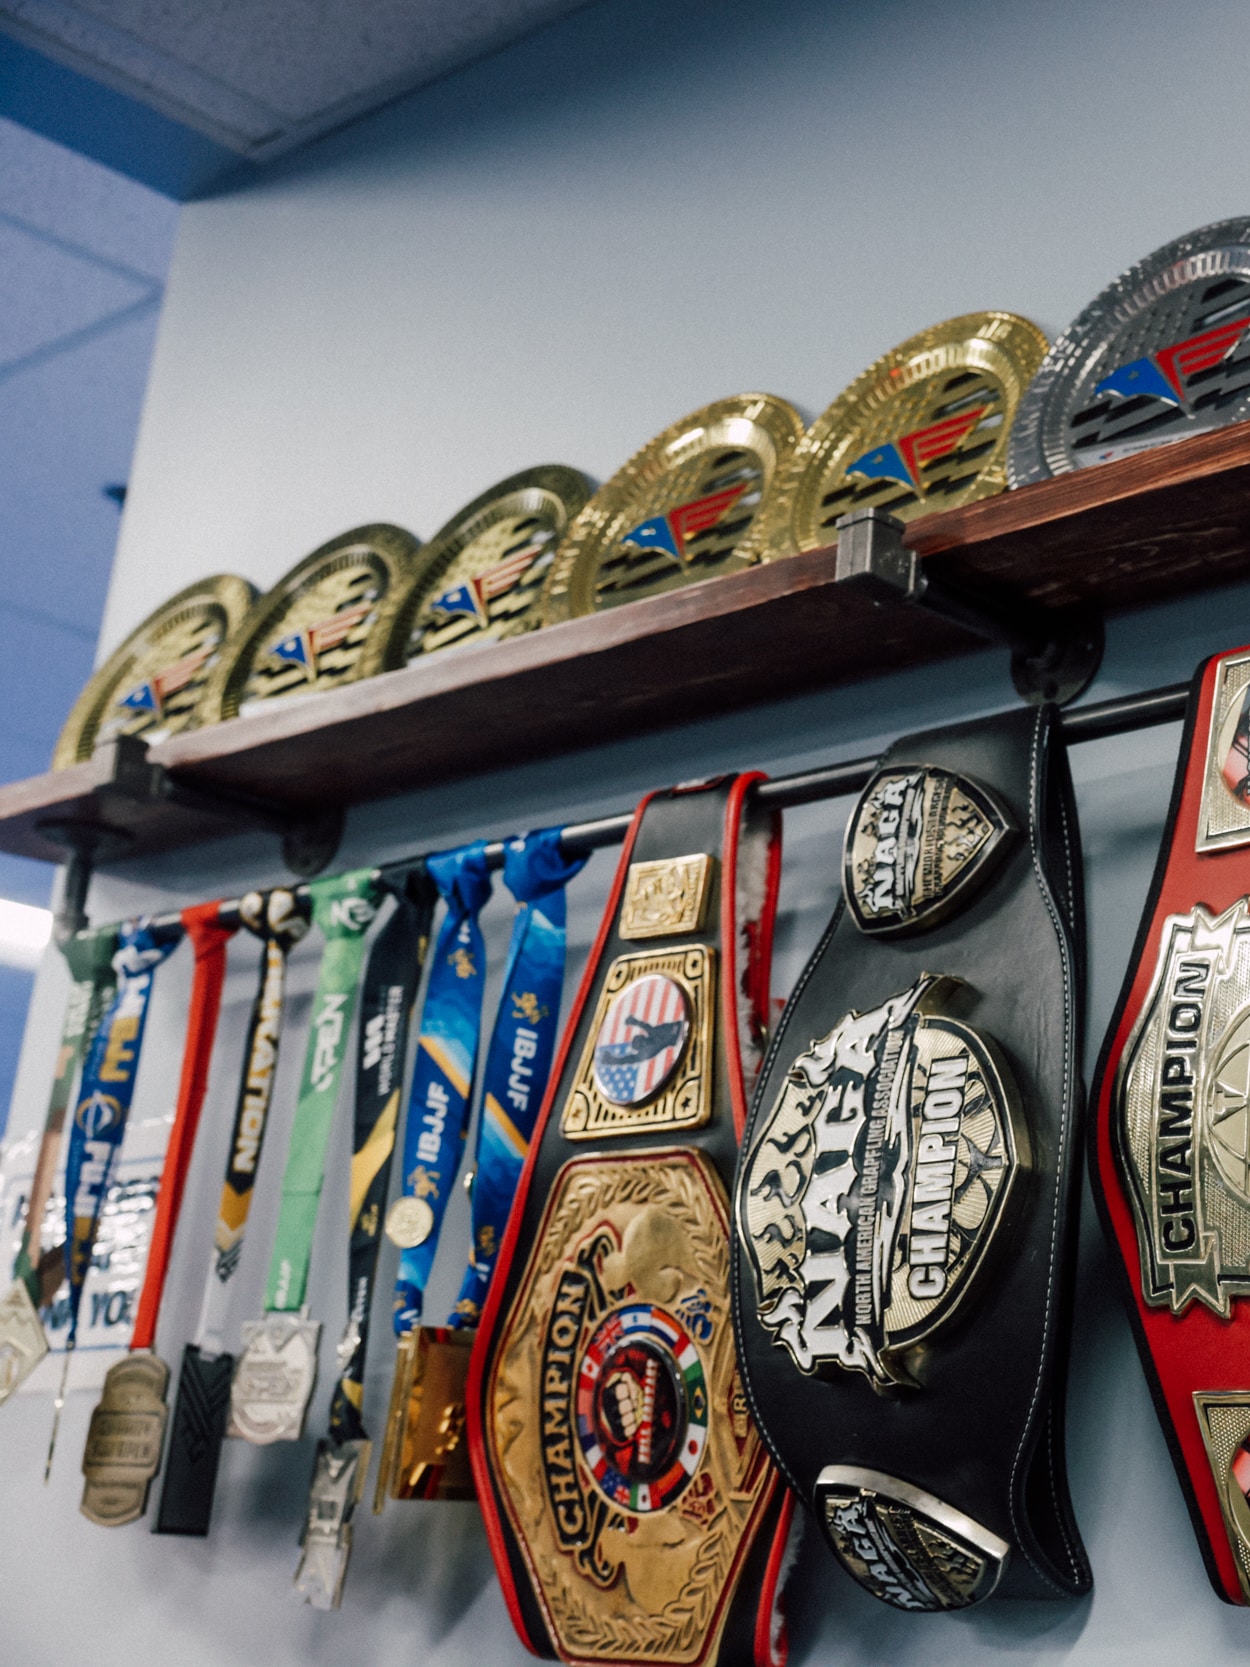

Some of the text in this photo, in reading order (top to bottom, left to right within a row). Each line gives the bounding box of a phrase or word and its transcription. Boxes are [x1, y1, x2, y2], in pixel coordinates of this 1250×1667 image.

[860, 772, 924, 913] NAGA
[416, 1081, 450, 1163] IBJJF
[507, 1027, 539, 1112] IBJJF
[768, 978, 922, 1376] NAGA
[855, 1023, 907, 1327] NORTH AMERICAN GRAPPLING ASSOCIATION
[909, 1055, 970, 1302] CHAMPION
[1159, 961, 1210, 1253] CHAMPION
[544, 1280, 590, 1539] CHAMPION
